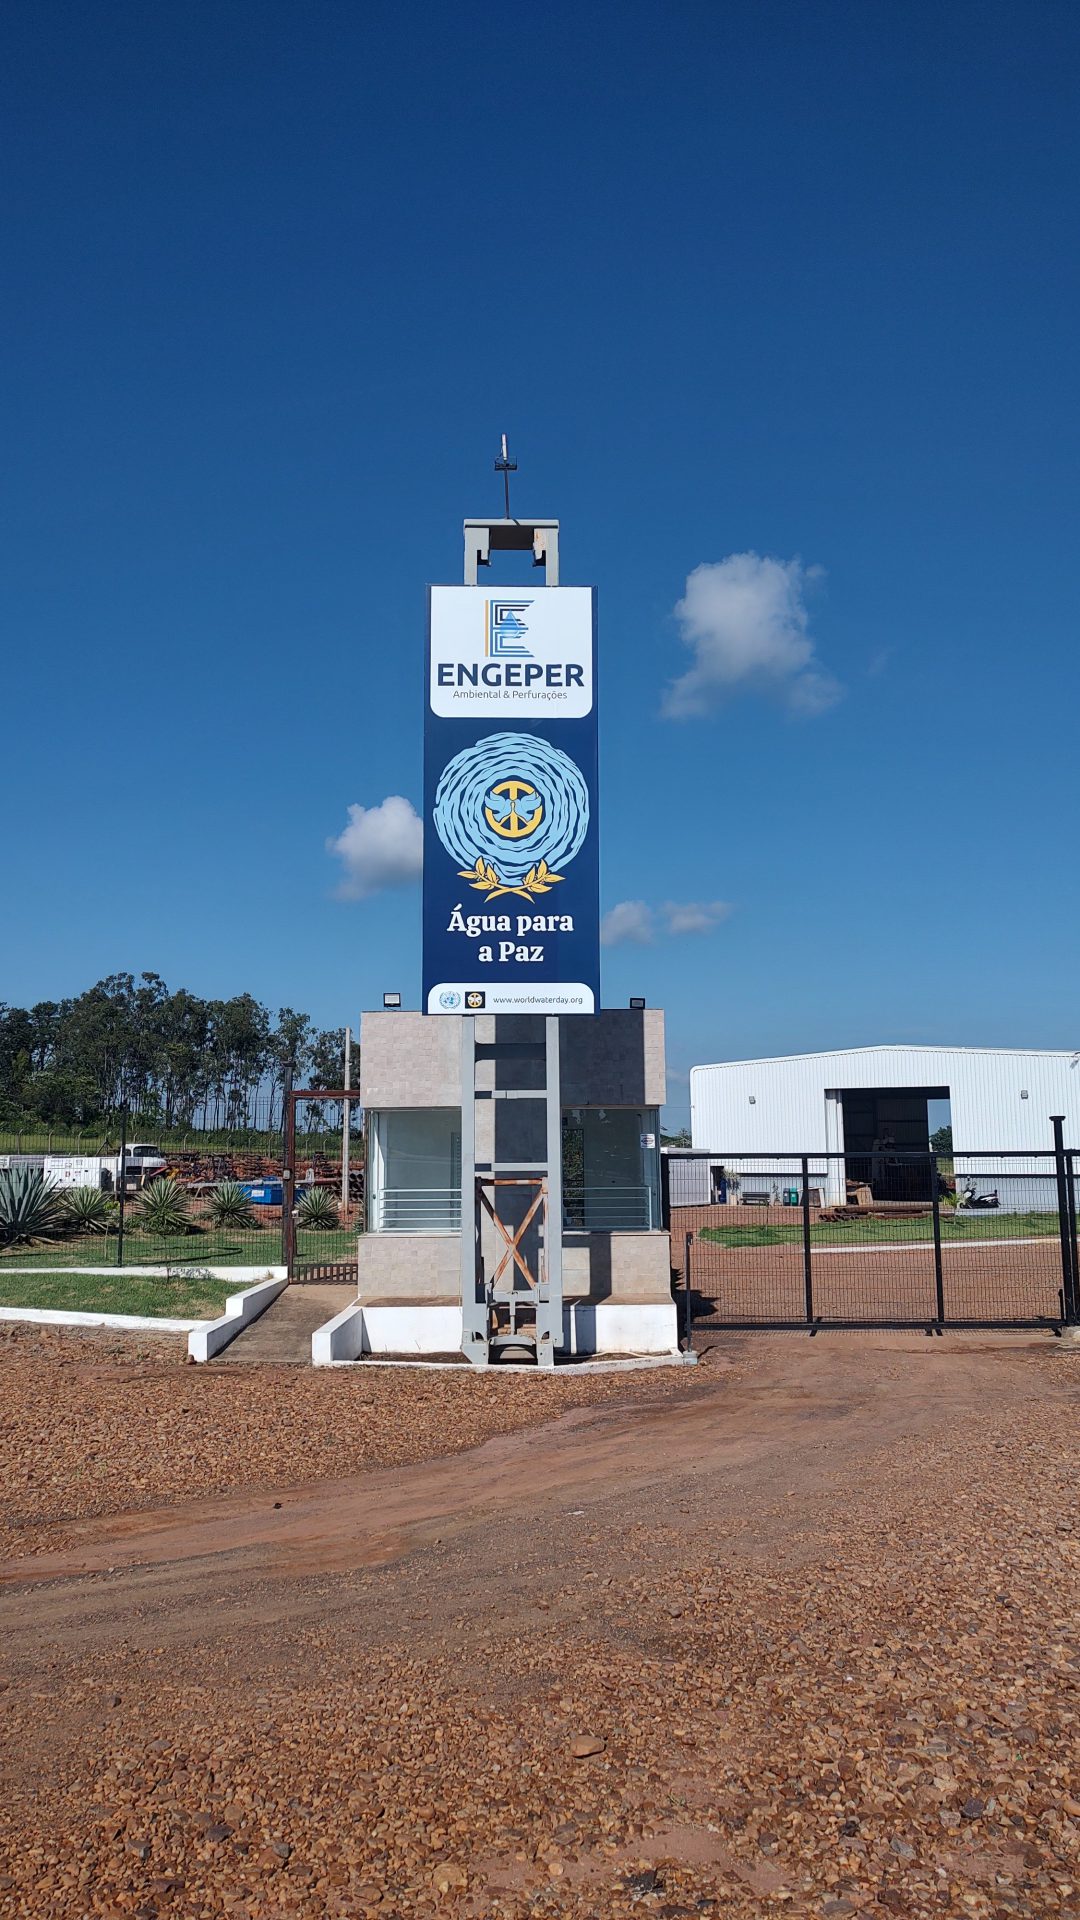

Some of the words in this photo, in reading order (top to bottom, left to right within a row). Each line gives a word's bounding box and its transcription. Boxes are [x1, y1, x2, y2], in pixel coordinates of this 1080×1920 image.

[437, 663, 584, 687] ENGEPER
[453, 690, 501, 699] Ambiental
[503, 690, 510, 699] &
[512, 690, 568, 700] Perfurações
[447, 903, 511, 937] Água
[516, 915, 574, 936] para
[478, 945, 493, 962] a
[499, 941, 544, 962] Paz
[493, 996, 583, 1004] www.worldwaterday.org
